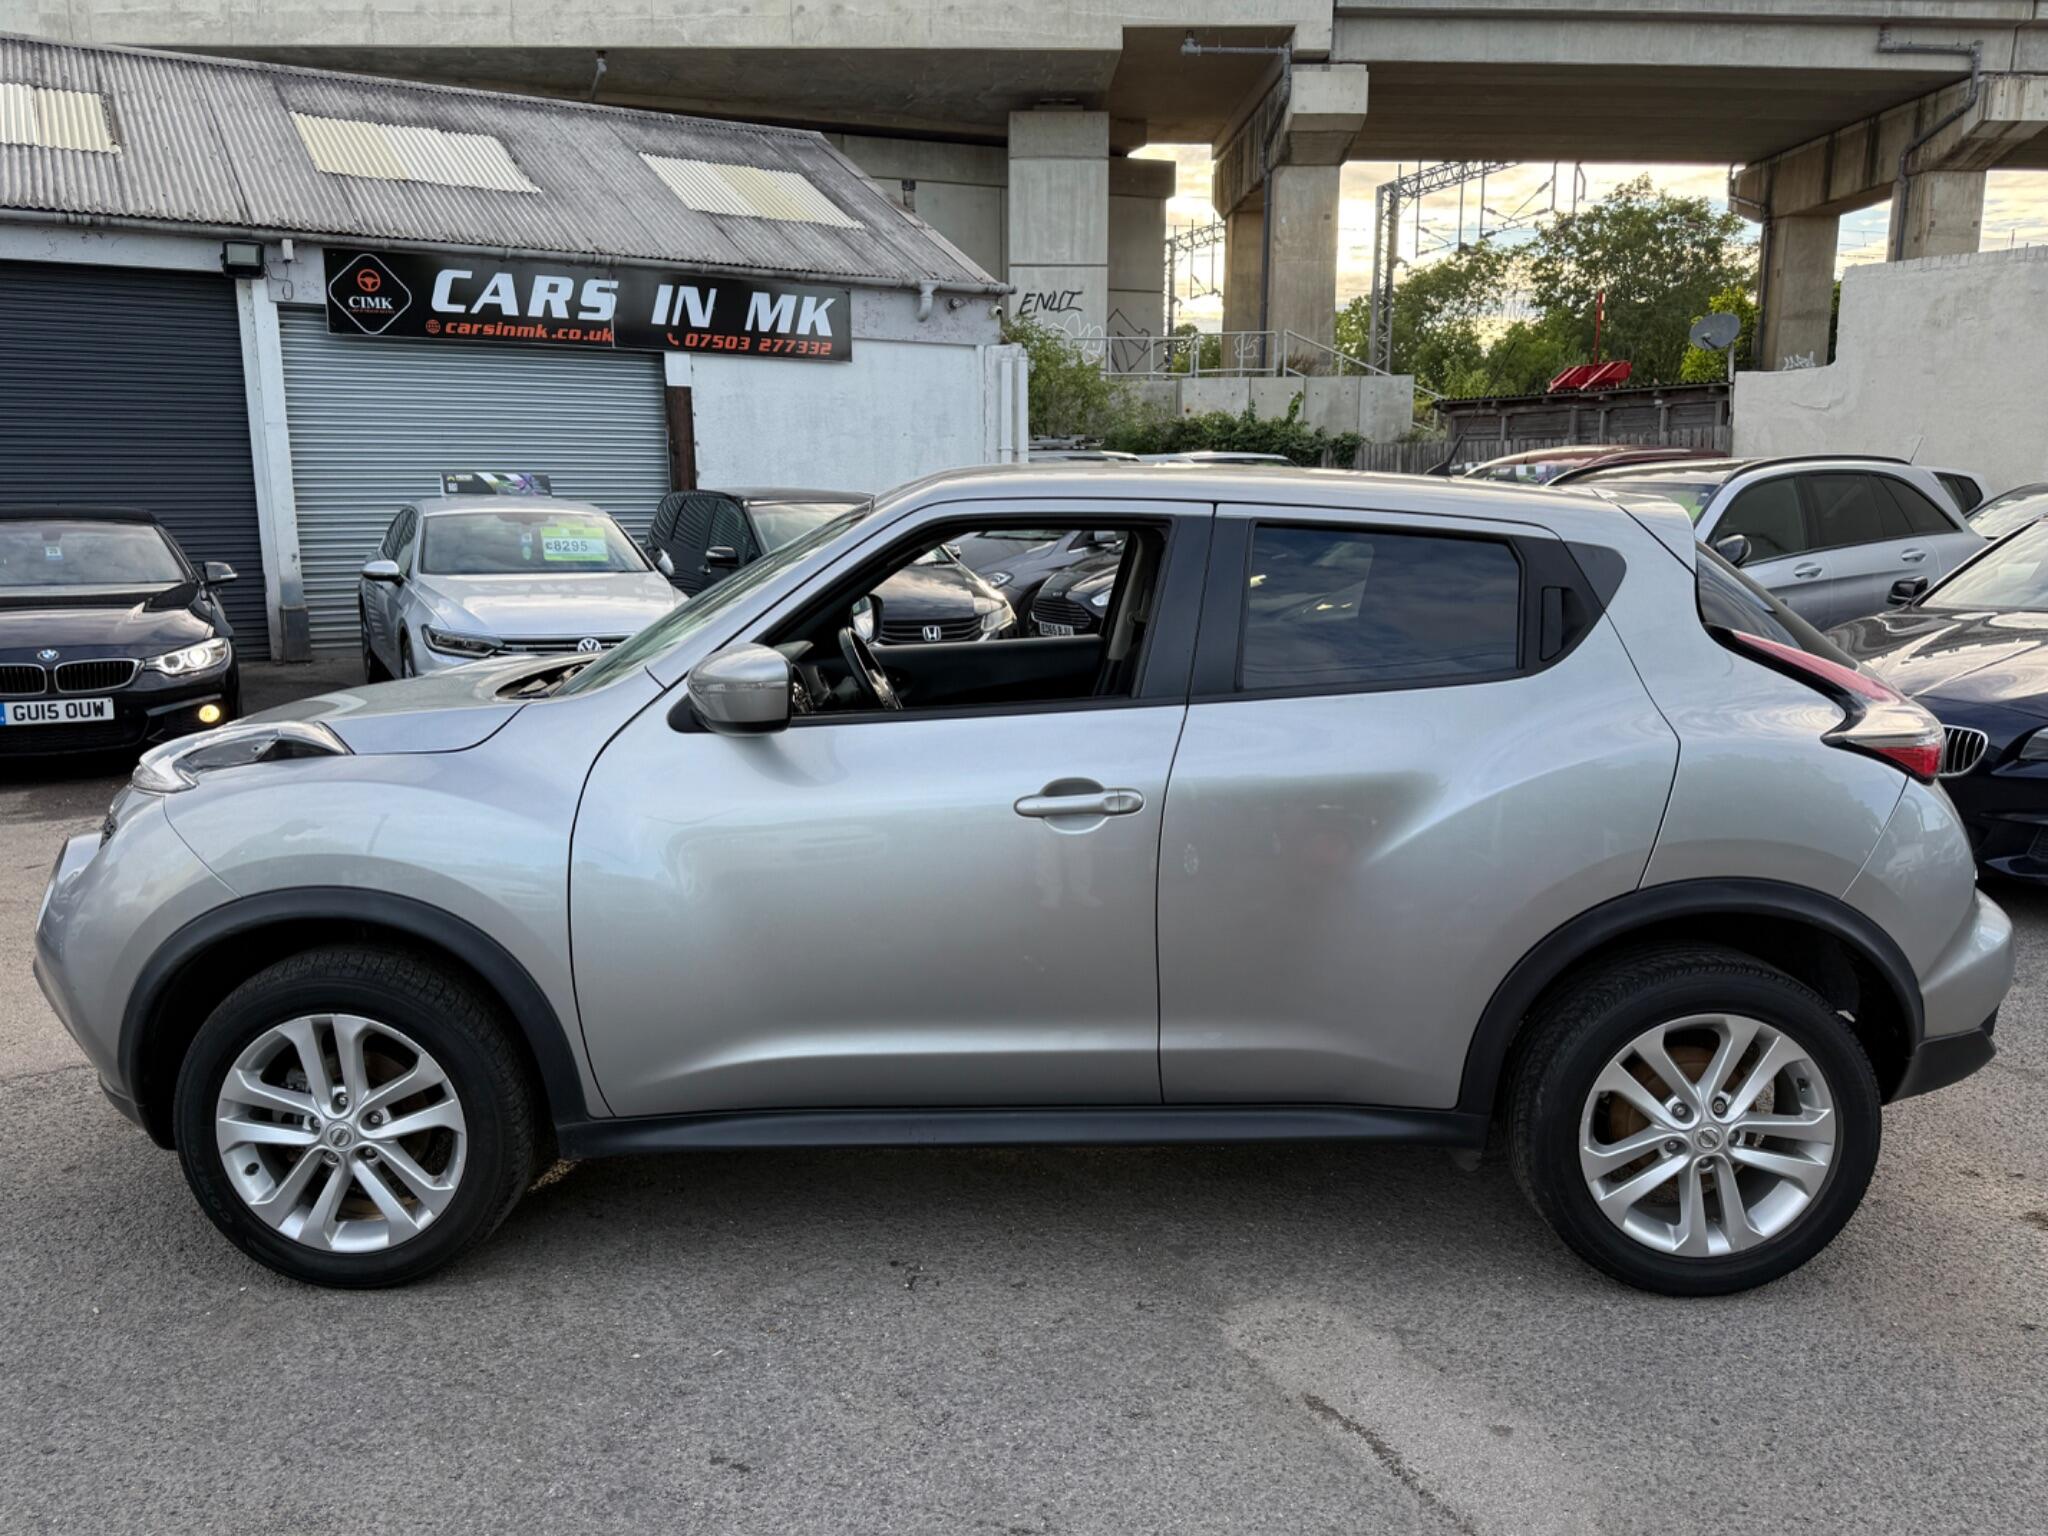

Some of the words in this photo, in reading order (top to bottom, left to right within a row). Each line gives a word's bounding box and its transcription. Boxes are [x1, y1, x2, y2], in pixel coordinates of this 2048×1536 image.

[348, 296, 393, 309] CIMK
[431, 269, 619, 321] CARS
[651, 284, 717, 328] IN
[744, 291, 836, 337] MK
[445, 321, 614, 342] carsinmk.co.uk
[685, 332, 750, 350] 07503
[759, 337, 833, 355] 277332
[13, 704, 59, 721] GU15
[65, 701, 104, 719] OUW
